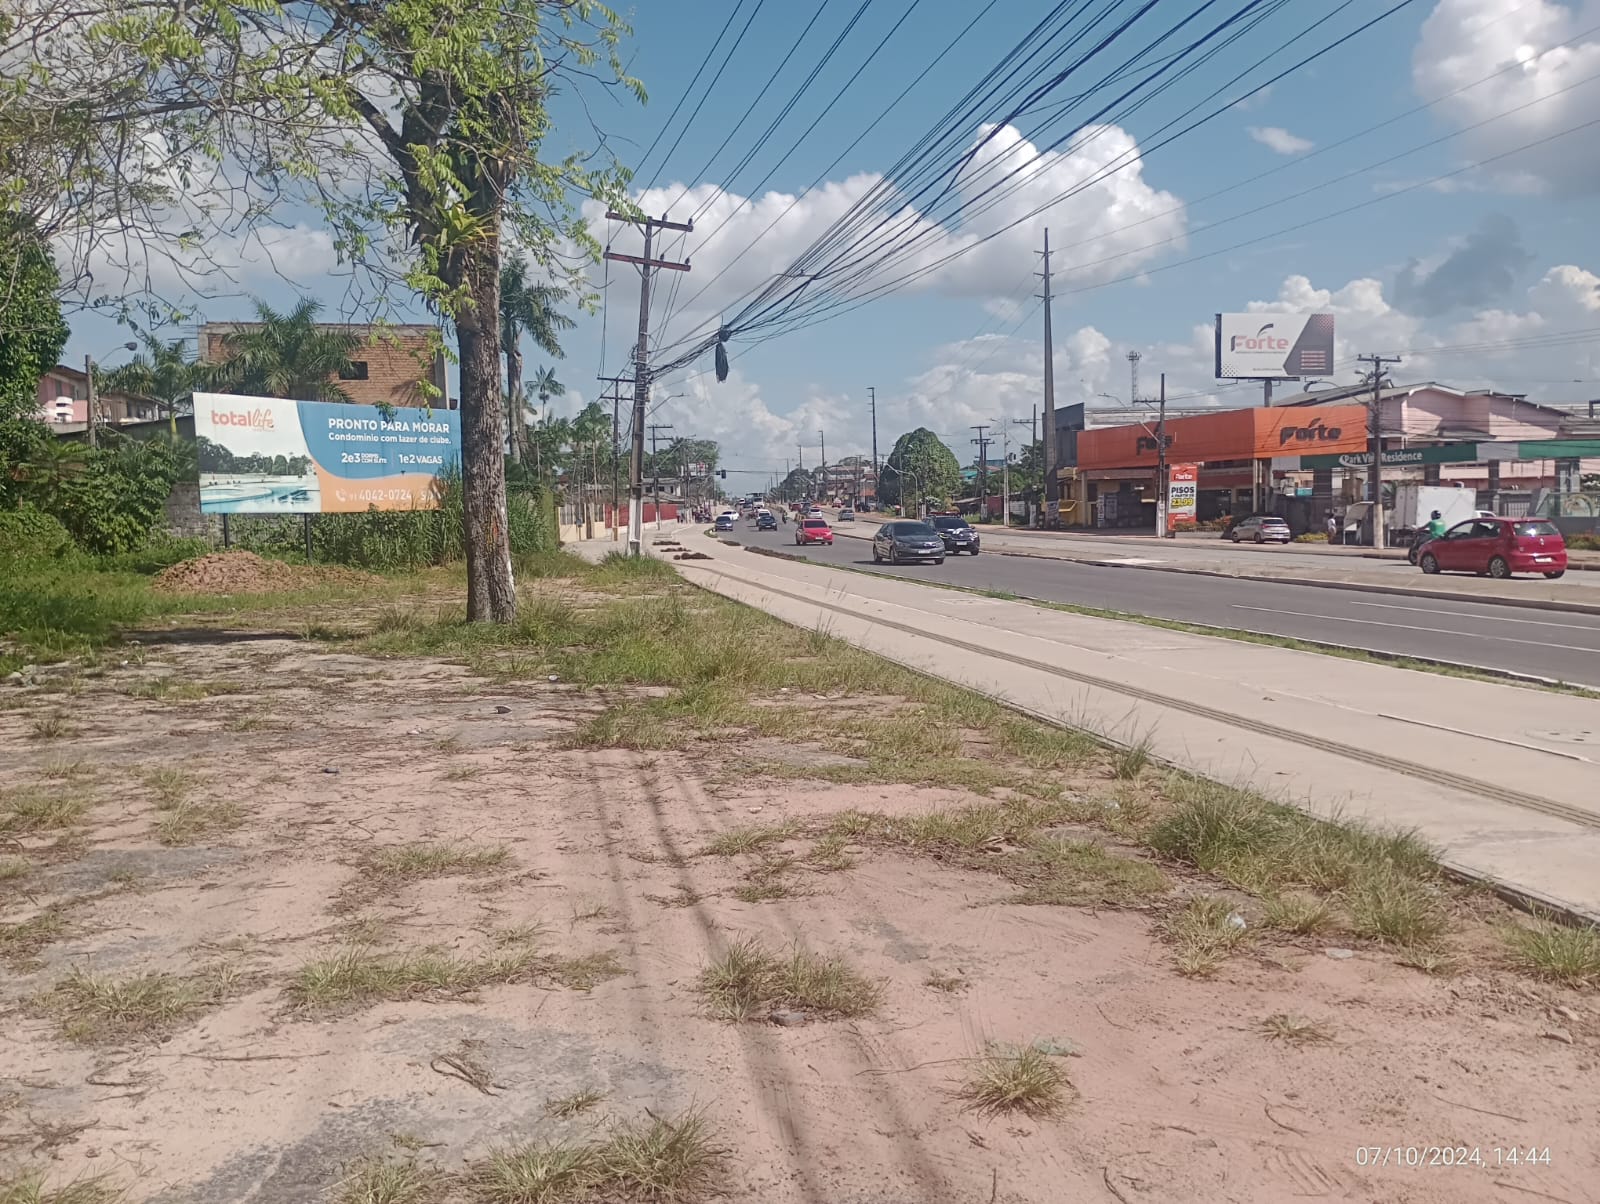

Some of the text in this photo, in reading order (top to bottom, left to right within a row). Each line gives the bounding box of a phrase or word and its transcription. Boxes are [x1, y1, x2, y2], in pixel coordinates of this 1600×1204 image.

[1231, 334, 1289, 352] Forte
[328, 418, 450, 433] PRONTO PARA MORAR
[380, 435, 398, 443] com
[399, 435, 417, 443] lazer
[418, 436, 429, 444] de
[417, 455, 442, 464] VAGAS
[1344, 455, 1362, 465] Park
[1381, 451, 1423, 463] Residence
